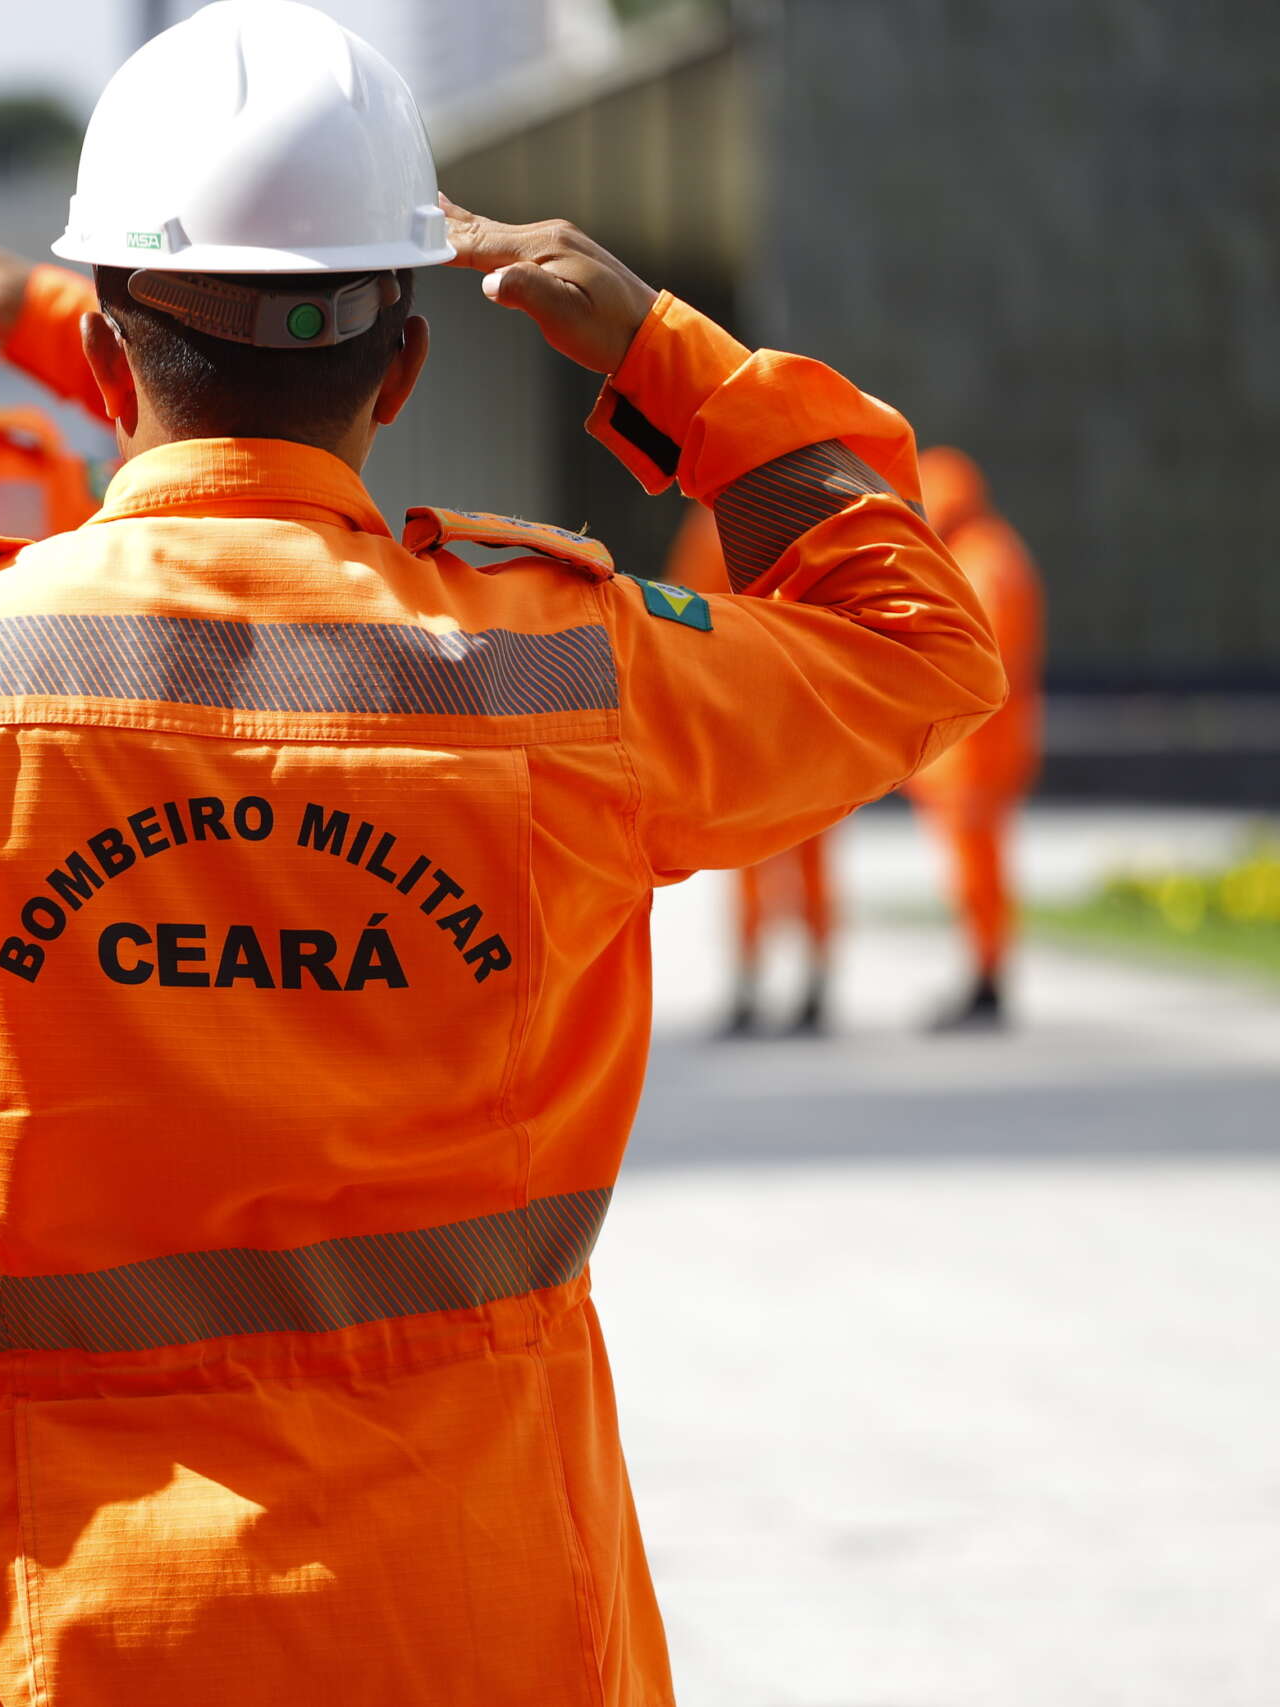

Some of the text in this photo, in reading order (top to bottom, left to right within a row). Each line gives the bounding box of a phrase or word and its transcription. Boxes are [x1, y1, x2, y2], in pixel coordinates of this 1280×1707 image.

[127, 232, 161, 249] MSA
[297, 802, 512, 983] MILITAR
[98, 913, 410, 992] CEARÁ
